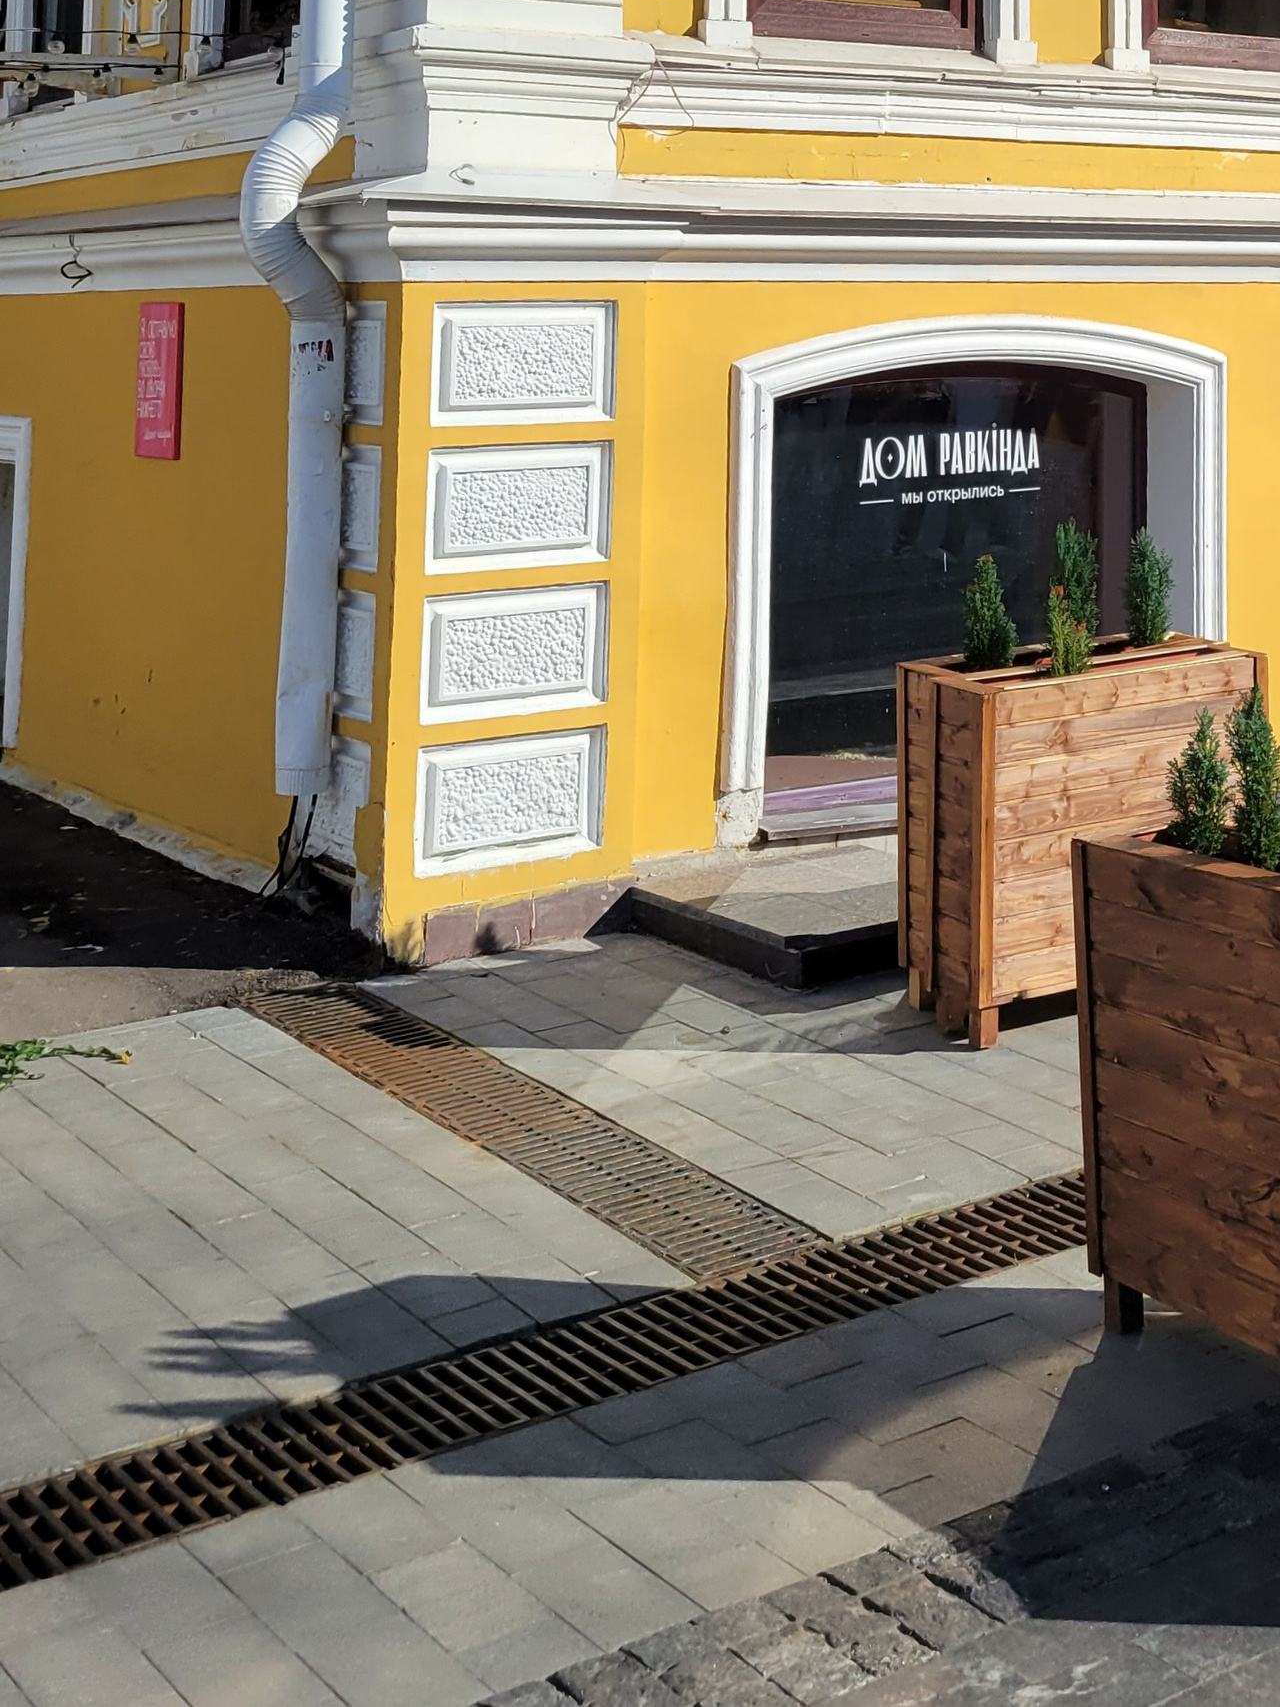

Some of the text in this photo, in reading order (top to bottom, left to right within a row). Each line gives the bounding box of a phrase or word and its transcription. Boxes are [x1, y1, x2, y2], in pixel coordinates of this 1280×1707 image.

[859, 434, 928, 488] ДОМ
[901, 485, 1005, 505] мы открылись
